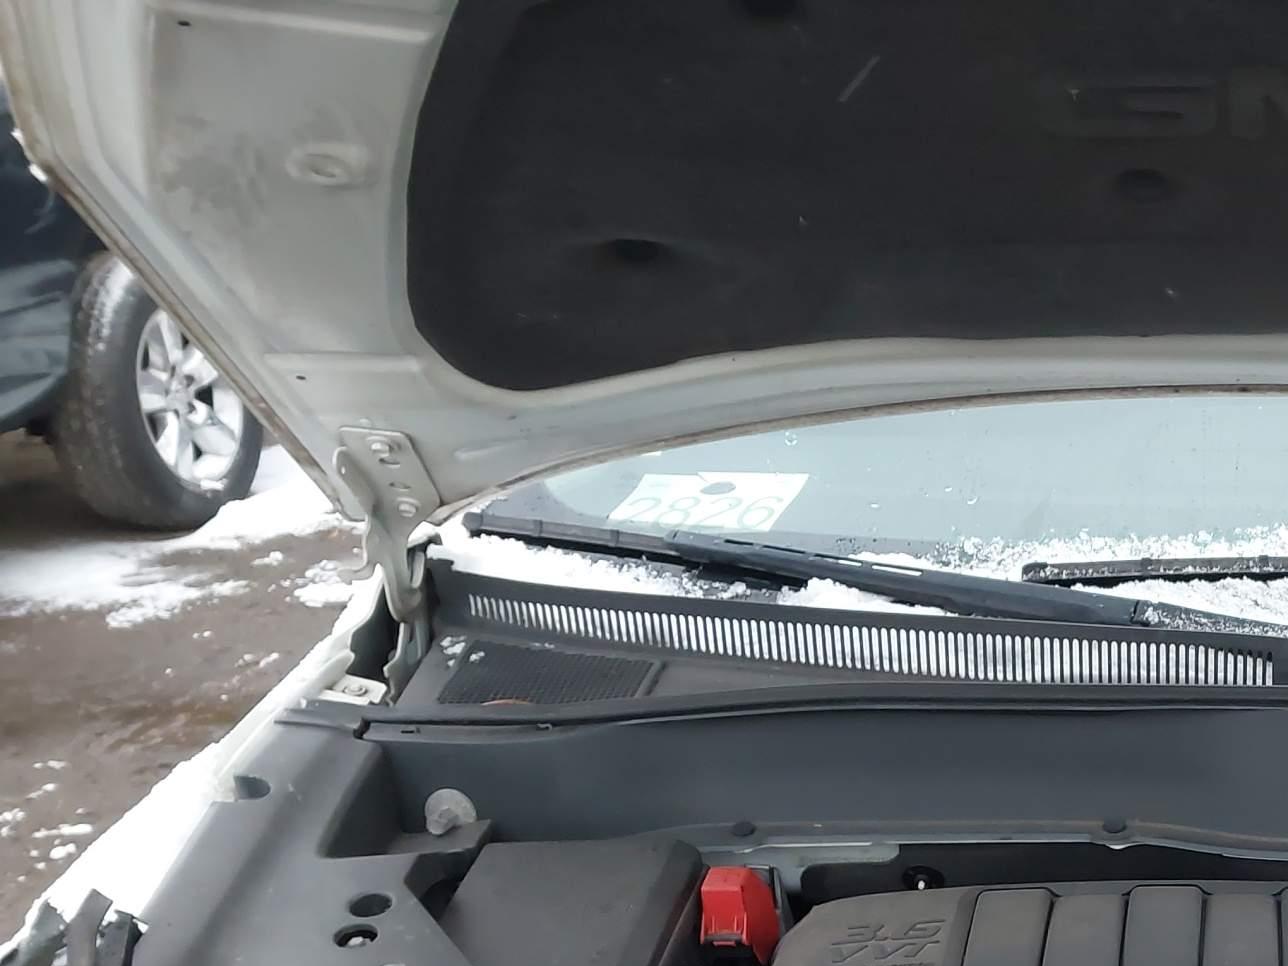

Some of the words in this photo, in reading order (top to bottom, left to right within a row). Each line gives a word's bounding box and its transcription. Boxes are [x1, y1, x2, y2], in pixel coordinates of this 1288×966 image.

[618, 496, 785, 530] 2826
[831, 919, 947, 945] 3.6
[831, 940, 941, 964] VVT
